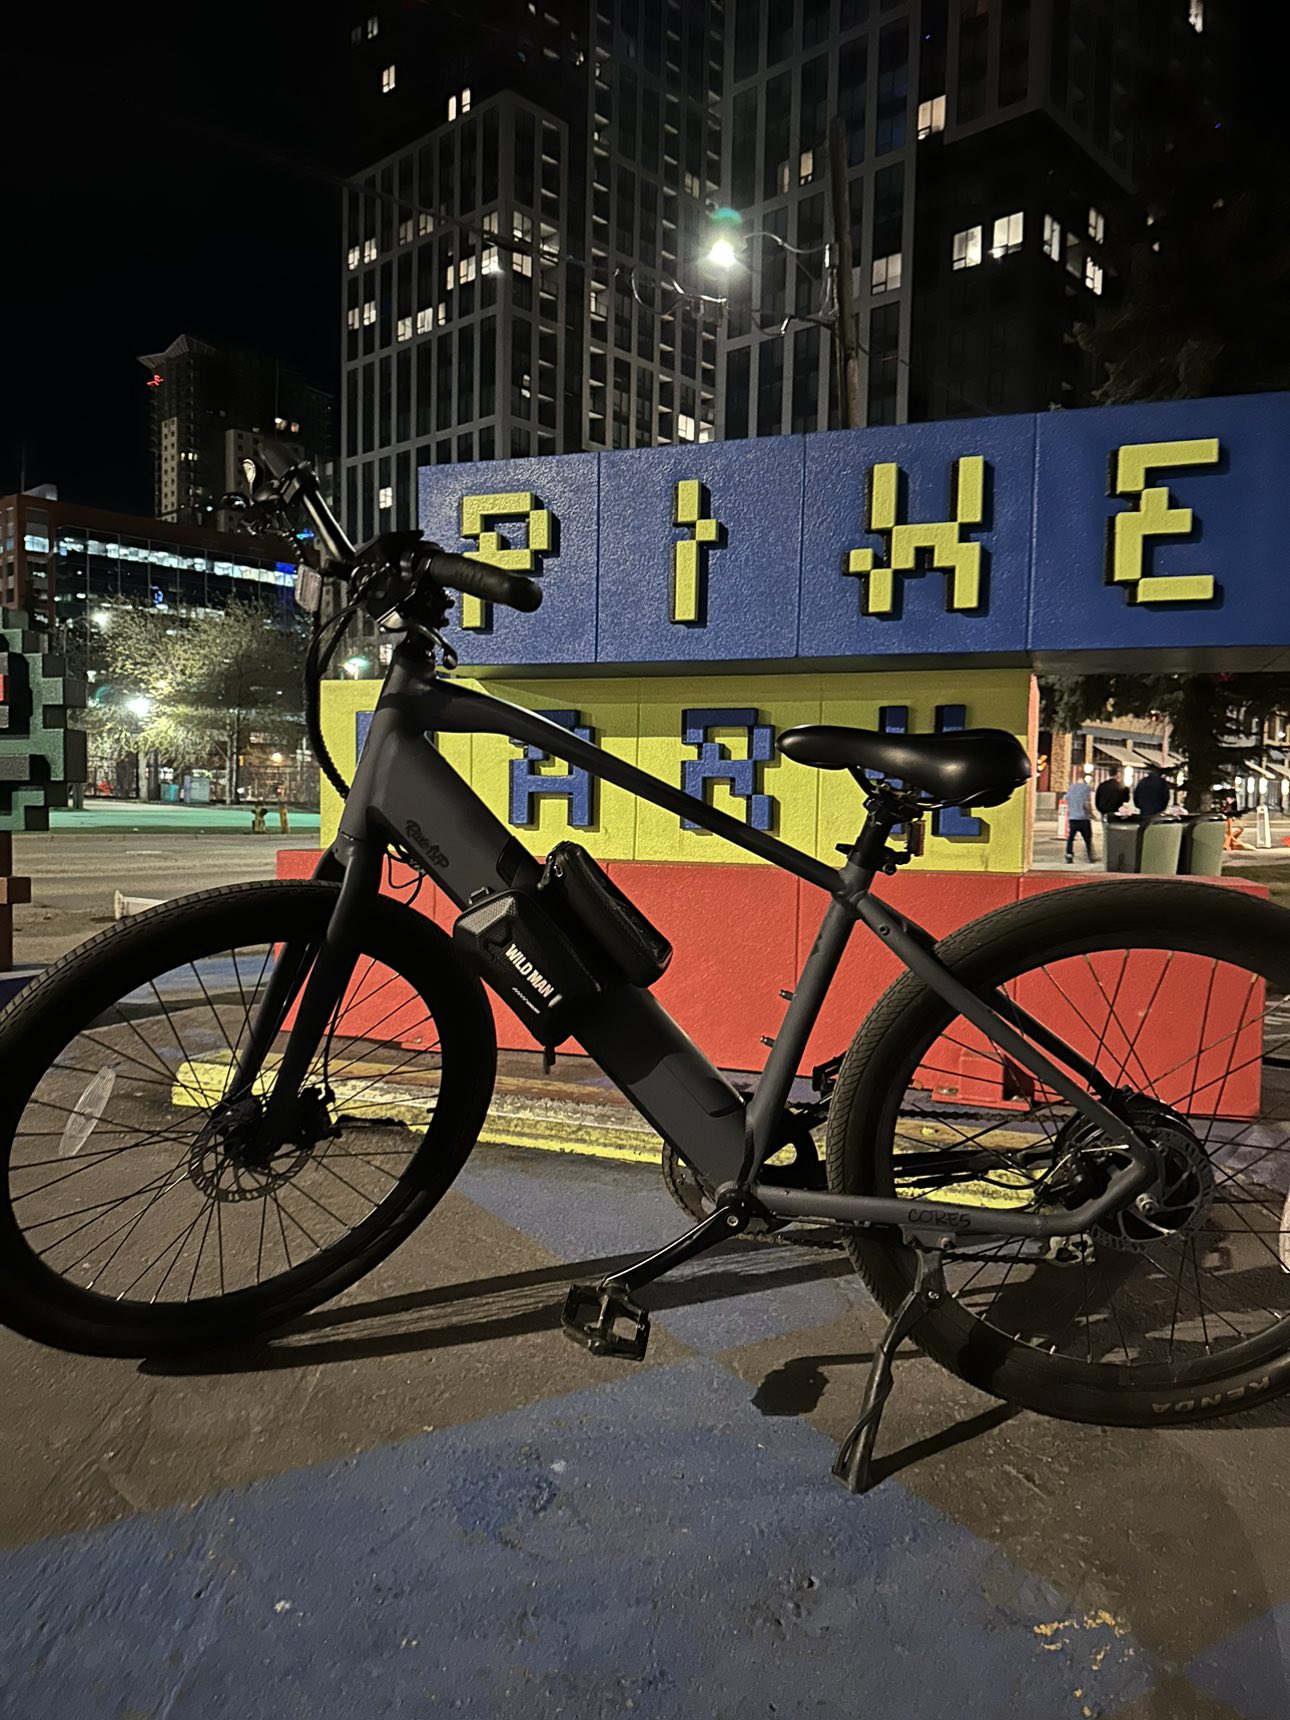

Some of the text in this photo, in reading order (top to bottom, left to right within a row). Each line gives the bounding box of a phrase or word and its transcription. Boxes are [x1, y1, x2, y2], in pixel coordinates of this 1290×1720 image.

[505, 943, 534, 976] WILD
[526, 969, 555, 998] MAN
[1151, 1376, 1270, 1413] KENDA
